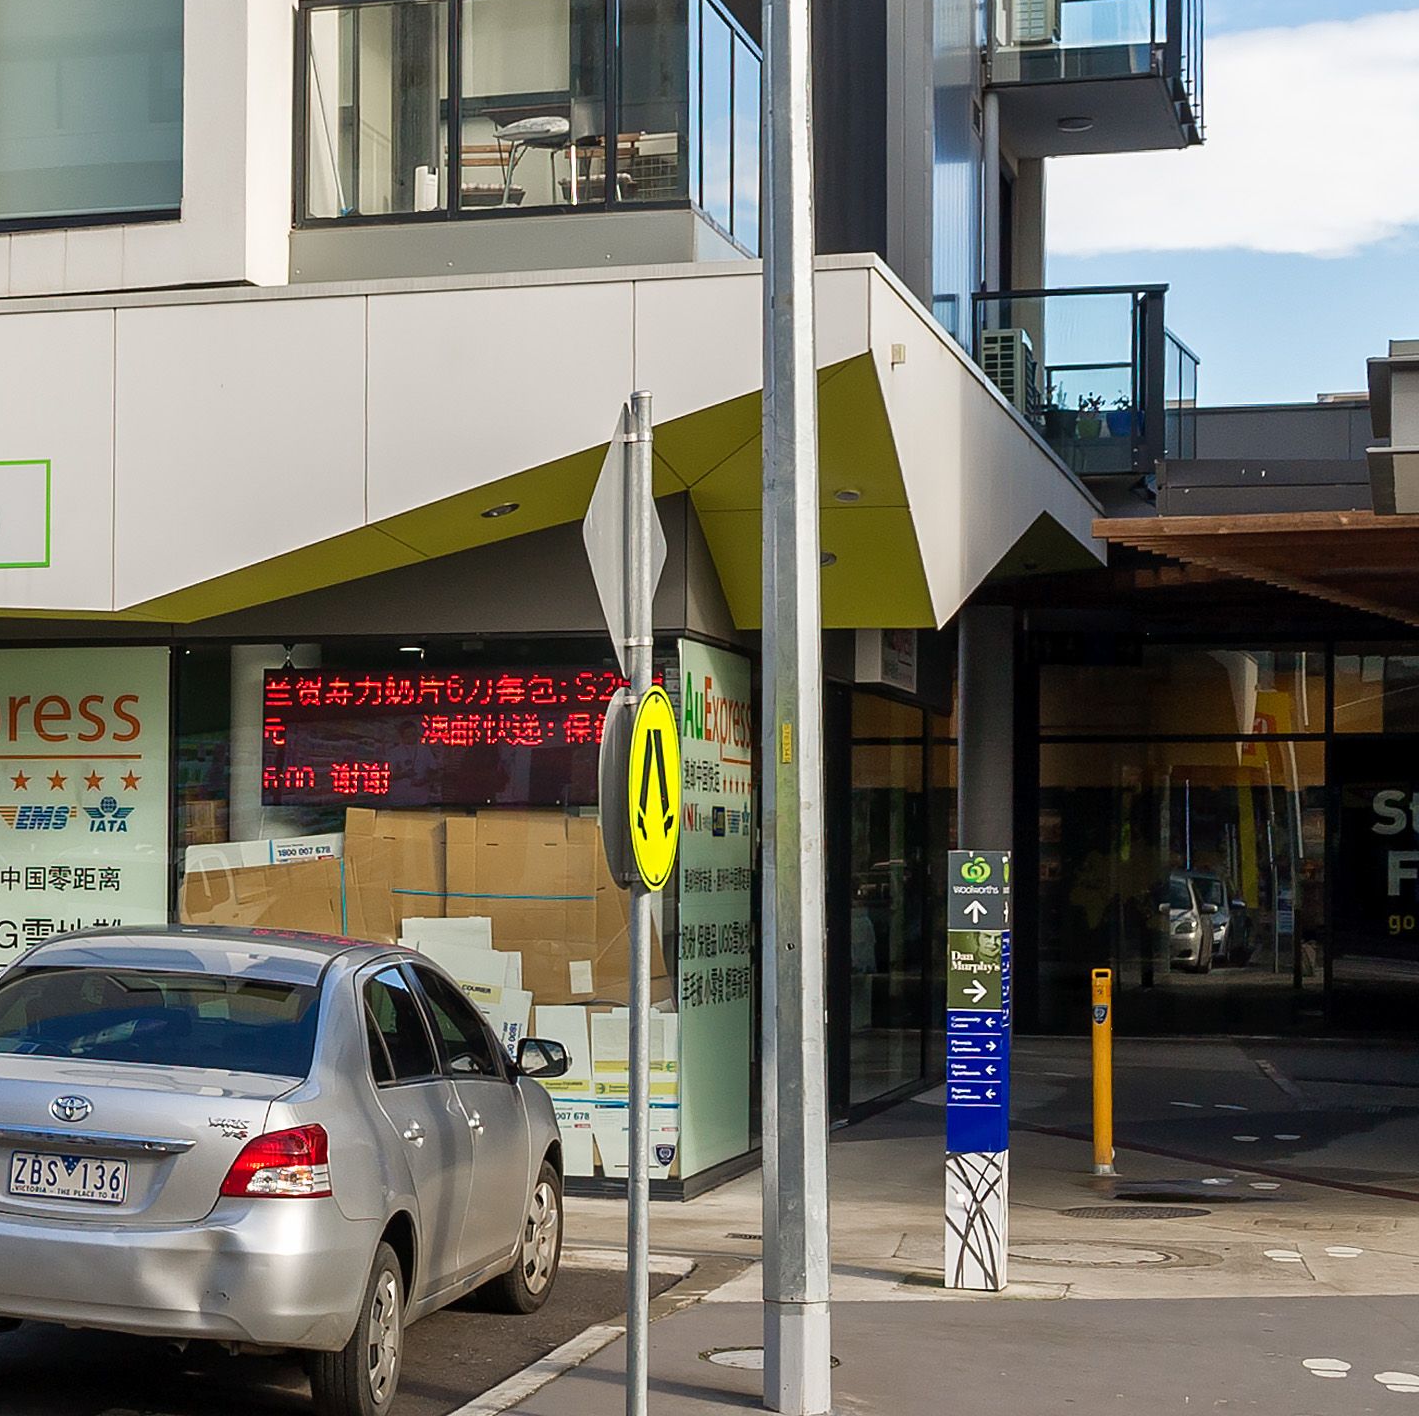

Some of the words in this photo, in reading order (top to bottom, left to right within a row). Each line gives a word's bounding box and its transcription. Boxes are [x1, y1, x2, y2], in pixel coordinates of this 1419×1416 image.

[682, 671, 751, 761] AuExpress
[14, 805, 71, 831] EMS
[89, 820, 128, 833] IATA
[951, 950, 975, 961] Dan
[951, 960, 1001, 974] Murphy's
[14, 1157, 59, 1186] ZBS
[82, 1162, 121, 1192] 136
